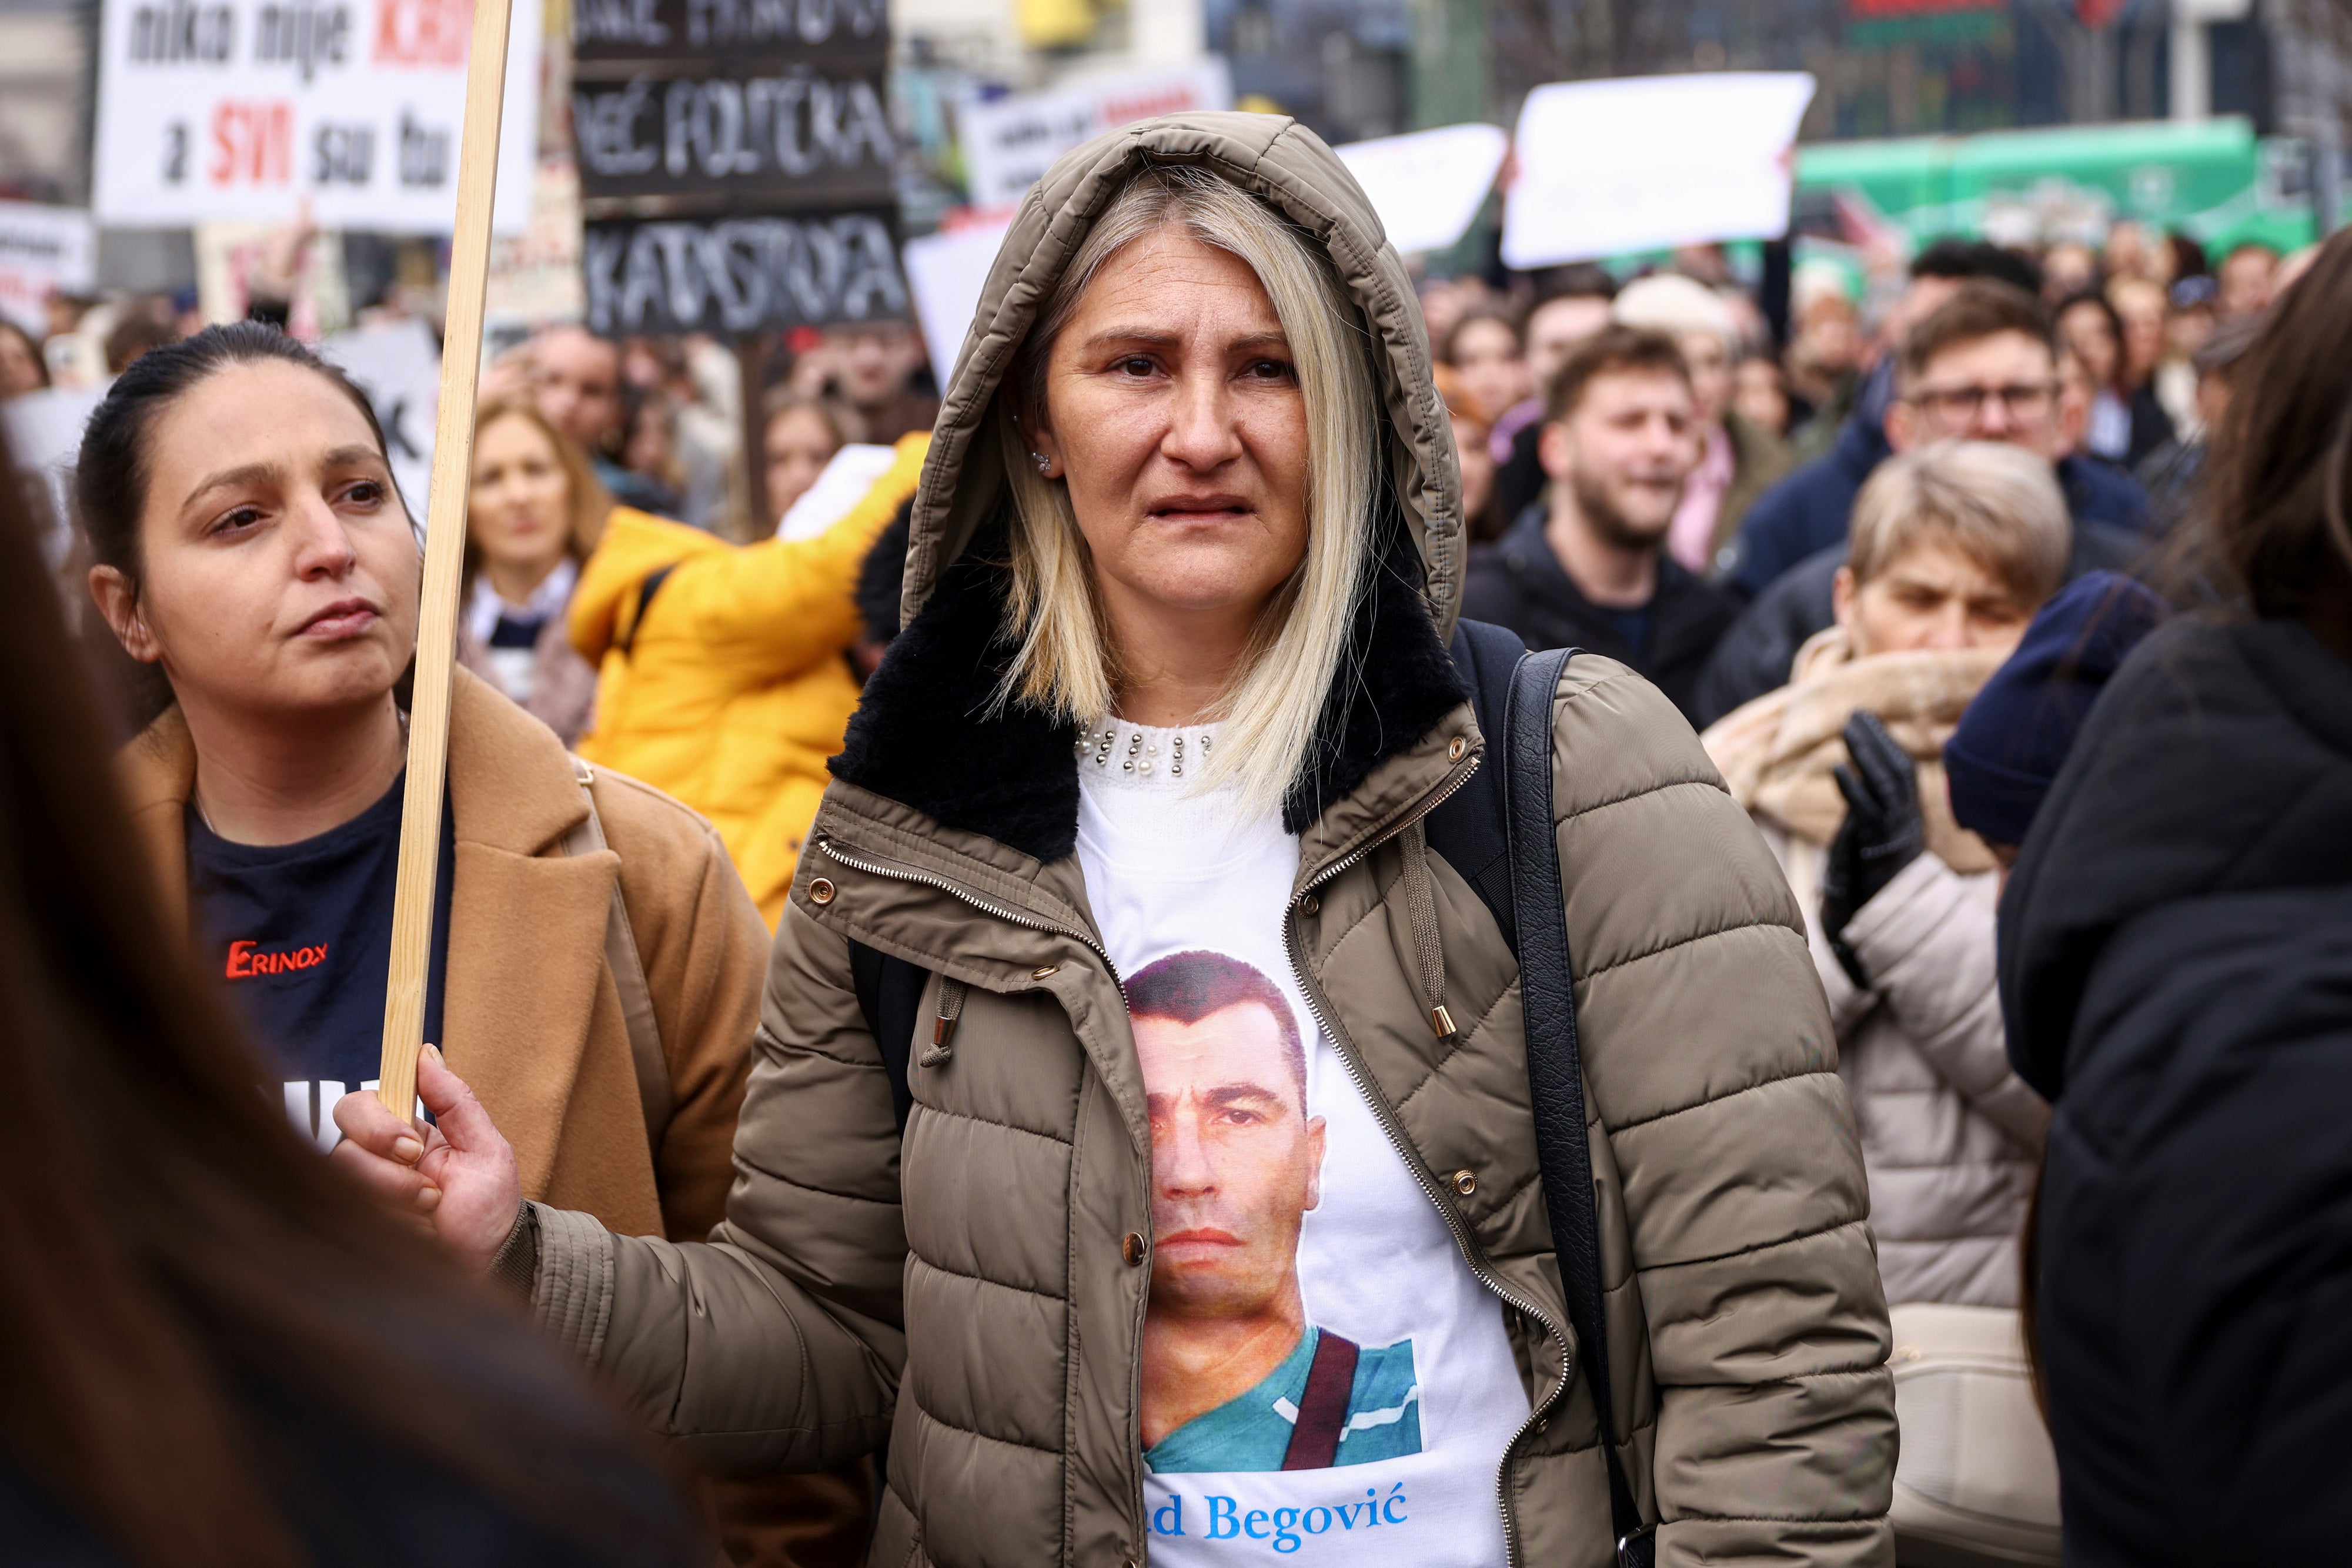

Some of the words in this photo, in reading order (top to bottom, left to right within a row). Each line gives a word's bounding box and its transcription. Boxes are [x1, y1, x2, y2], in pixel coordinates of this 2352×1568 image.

[163, 122, 189, 185] a
[209, 100, 292, 186] SVI
[313, 126, 374, 186] su
[399, 113, 448, 188] tu
[1145, 1494, 1186, 1536] d
[1204, 1482, 1408, 1553] Begović
